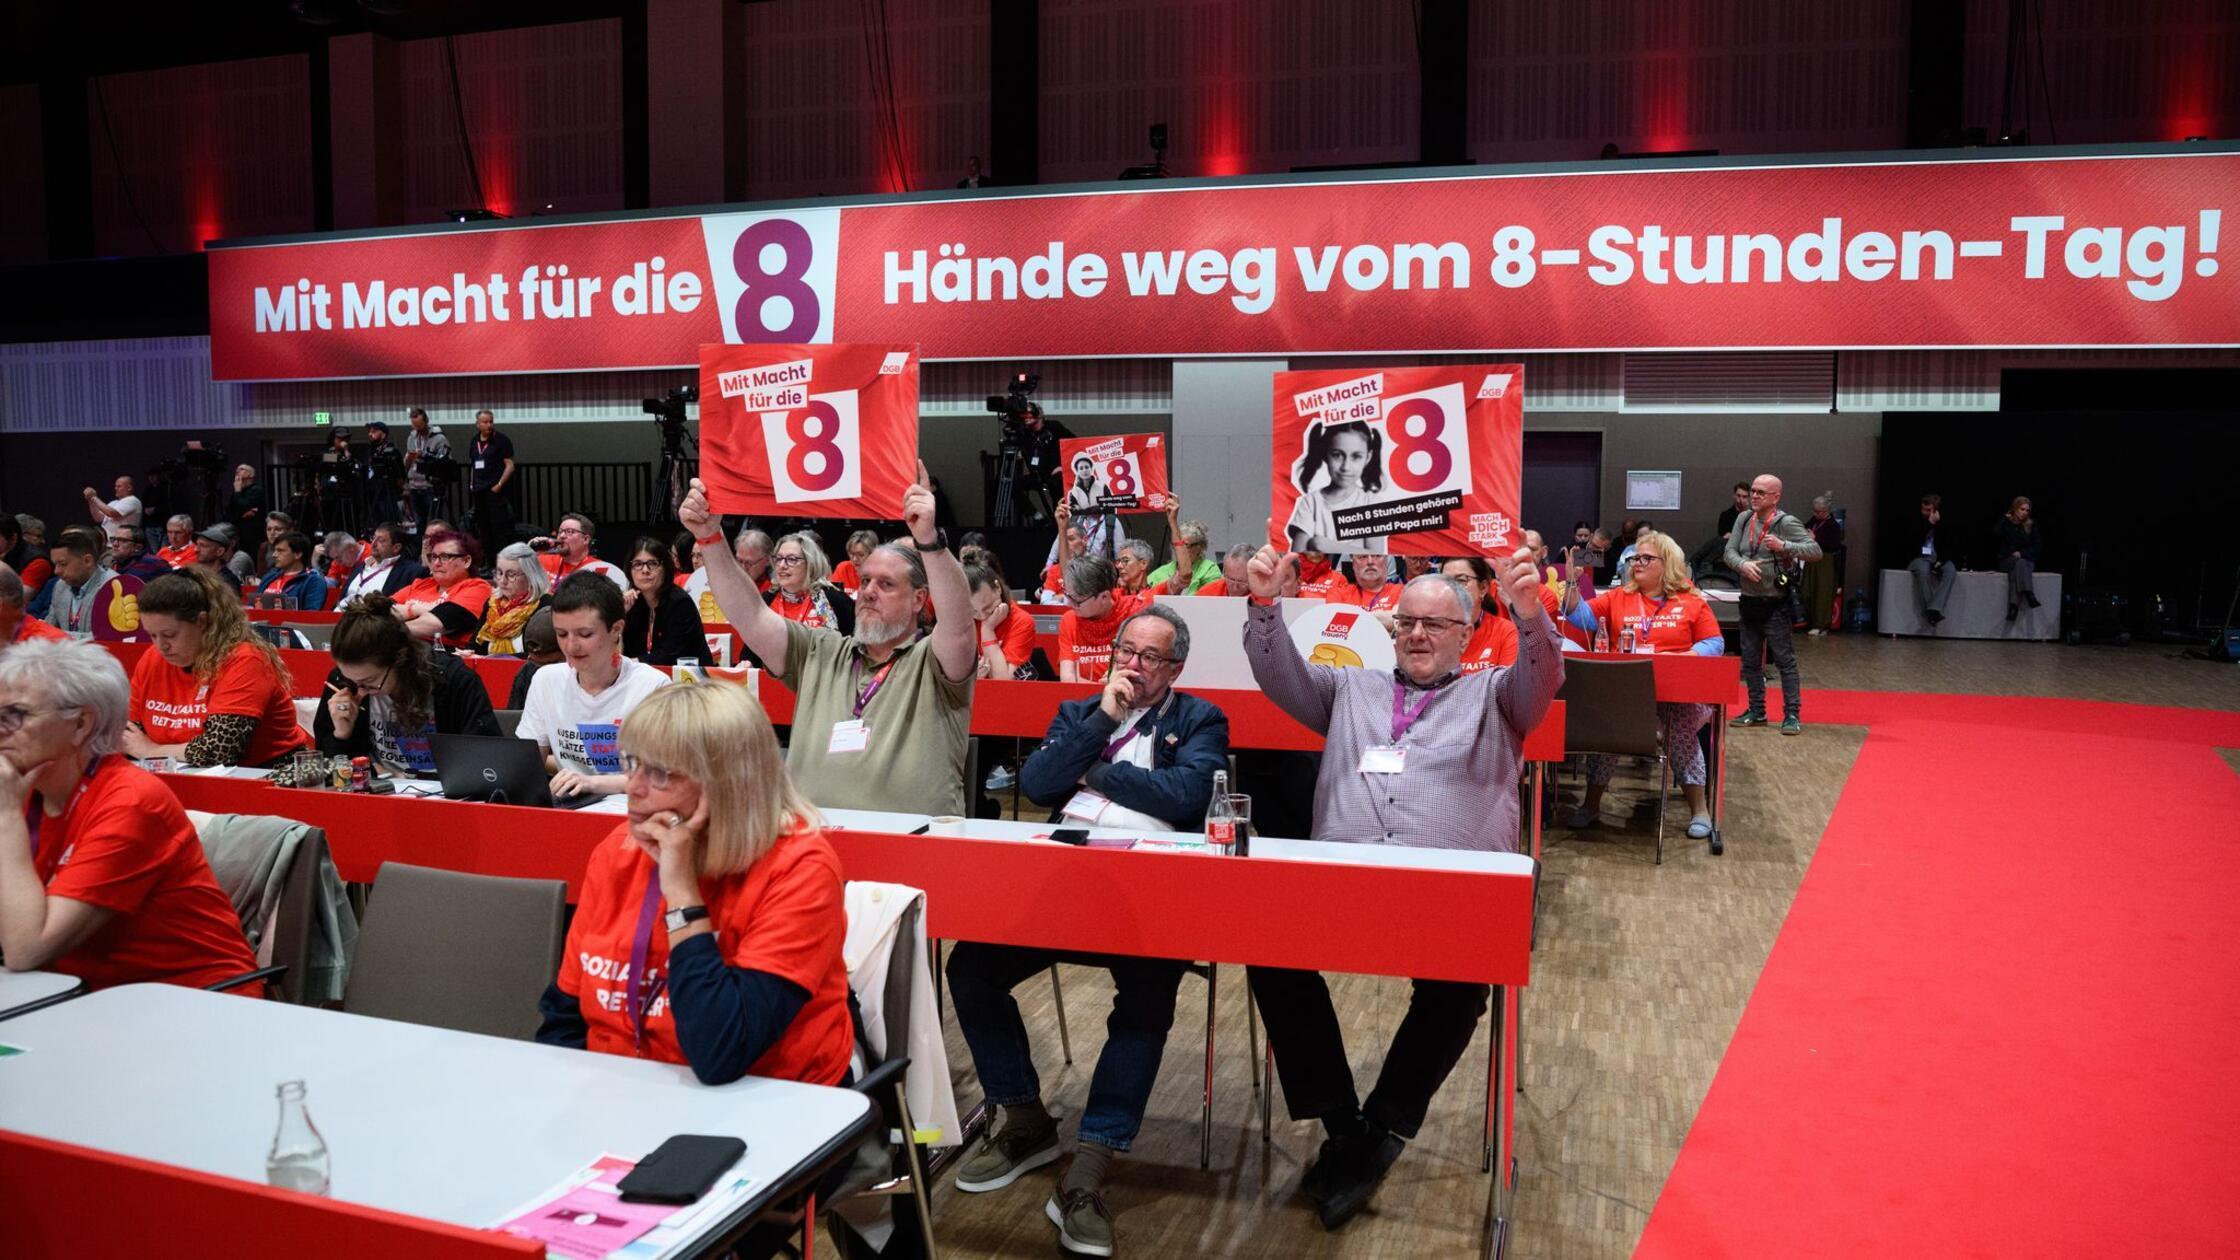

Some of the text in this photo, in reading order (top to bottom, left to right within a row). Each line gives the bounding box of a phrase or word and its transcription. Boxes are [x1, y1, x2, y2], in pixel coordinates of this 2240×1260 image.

[884, 209, 2221, 314] Hände weg vom 8-Stunden-Tag!
[254, 218, 821, 344] Mit Macht für die 8
[723, 365, 806, 392] Mit Macht
[882, 364, 900, 373] DGB
[749, 389, 802, 408] für die
[1300, 379, 1377, 411] Mit Macht
[1481, 388, 1501, 397] DGB
[1324, 403, 1374, 423] für die
[786, 400, 844, 491] 8
[1386, 398, 1452, 493] 8
[1107, 459, 1135, 495] 8
[1337, 495, 1458, 525] Nach 8 Stunden gehören
[1472, 514, 1499, 522] MACH
[1340, 515, 1443, 538] Mama und Papa mir!
[1478, 521, 1507, 532] DICH
[1329, 624, 1348, 632] DGB
